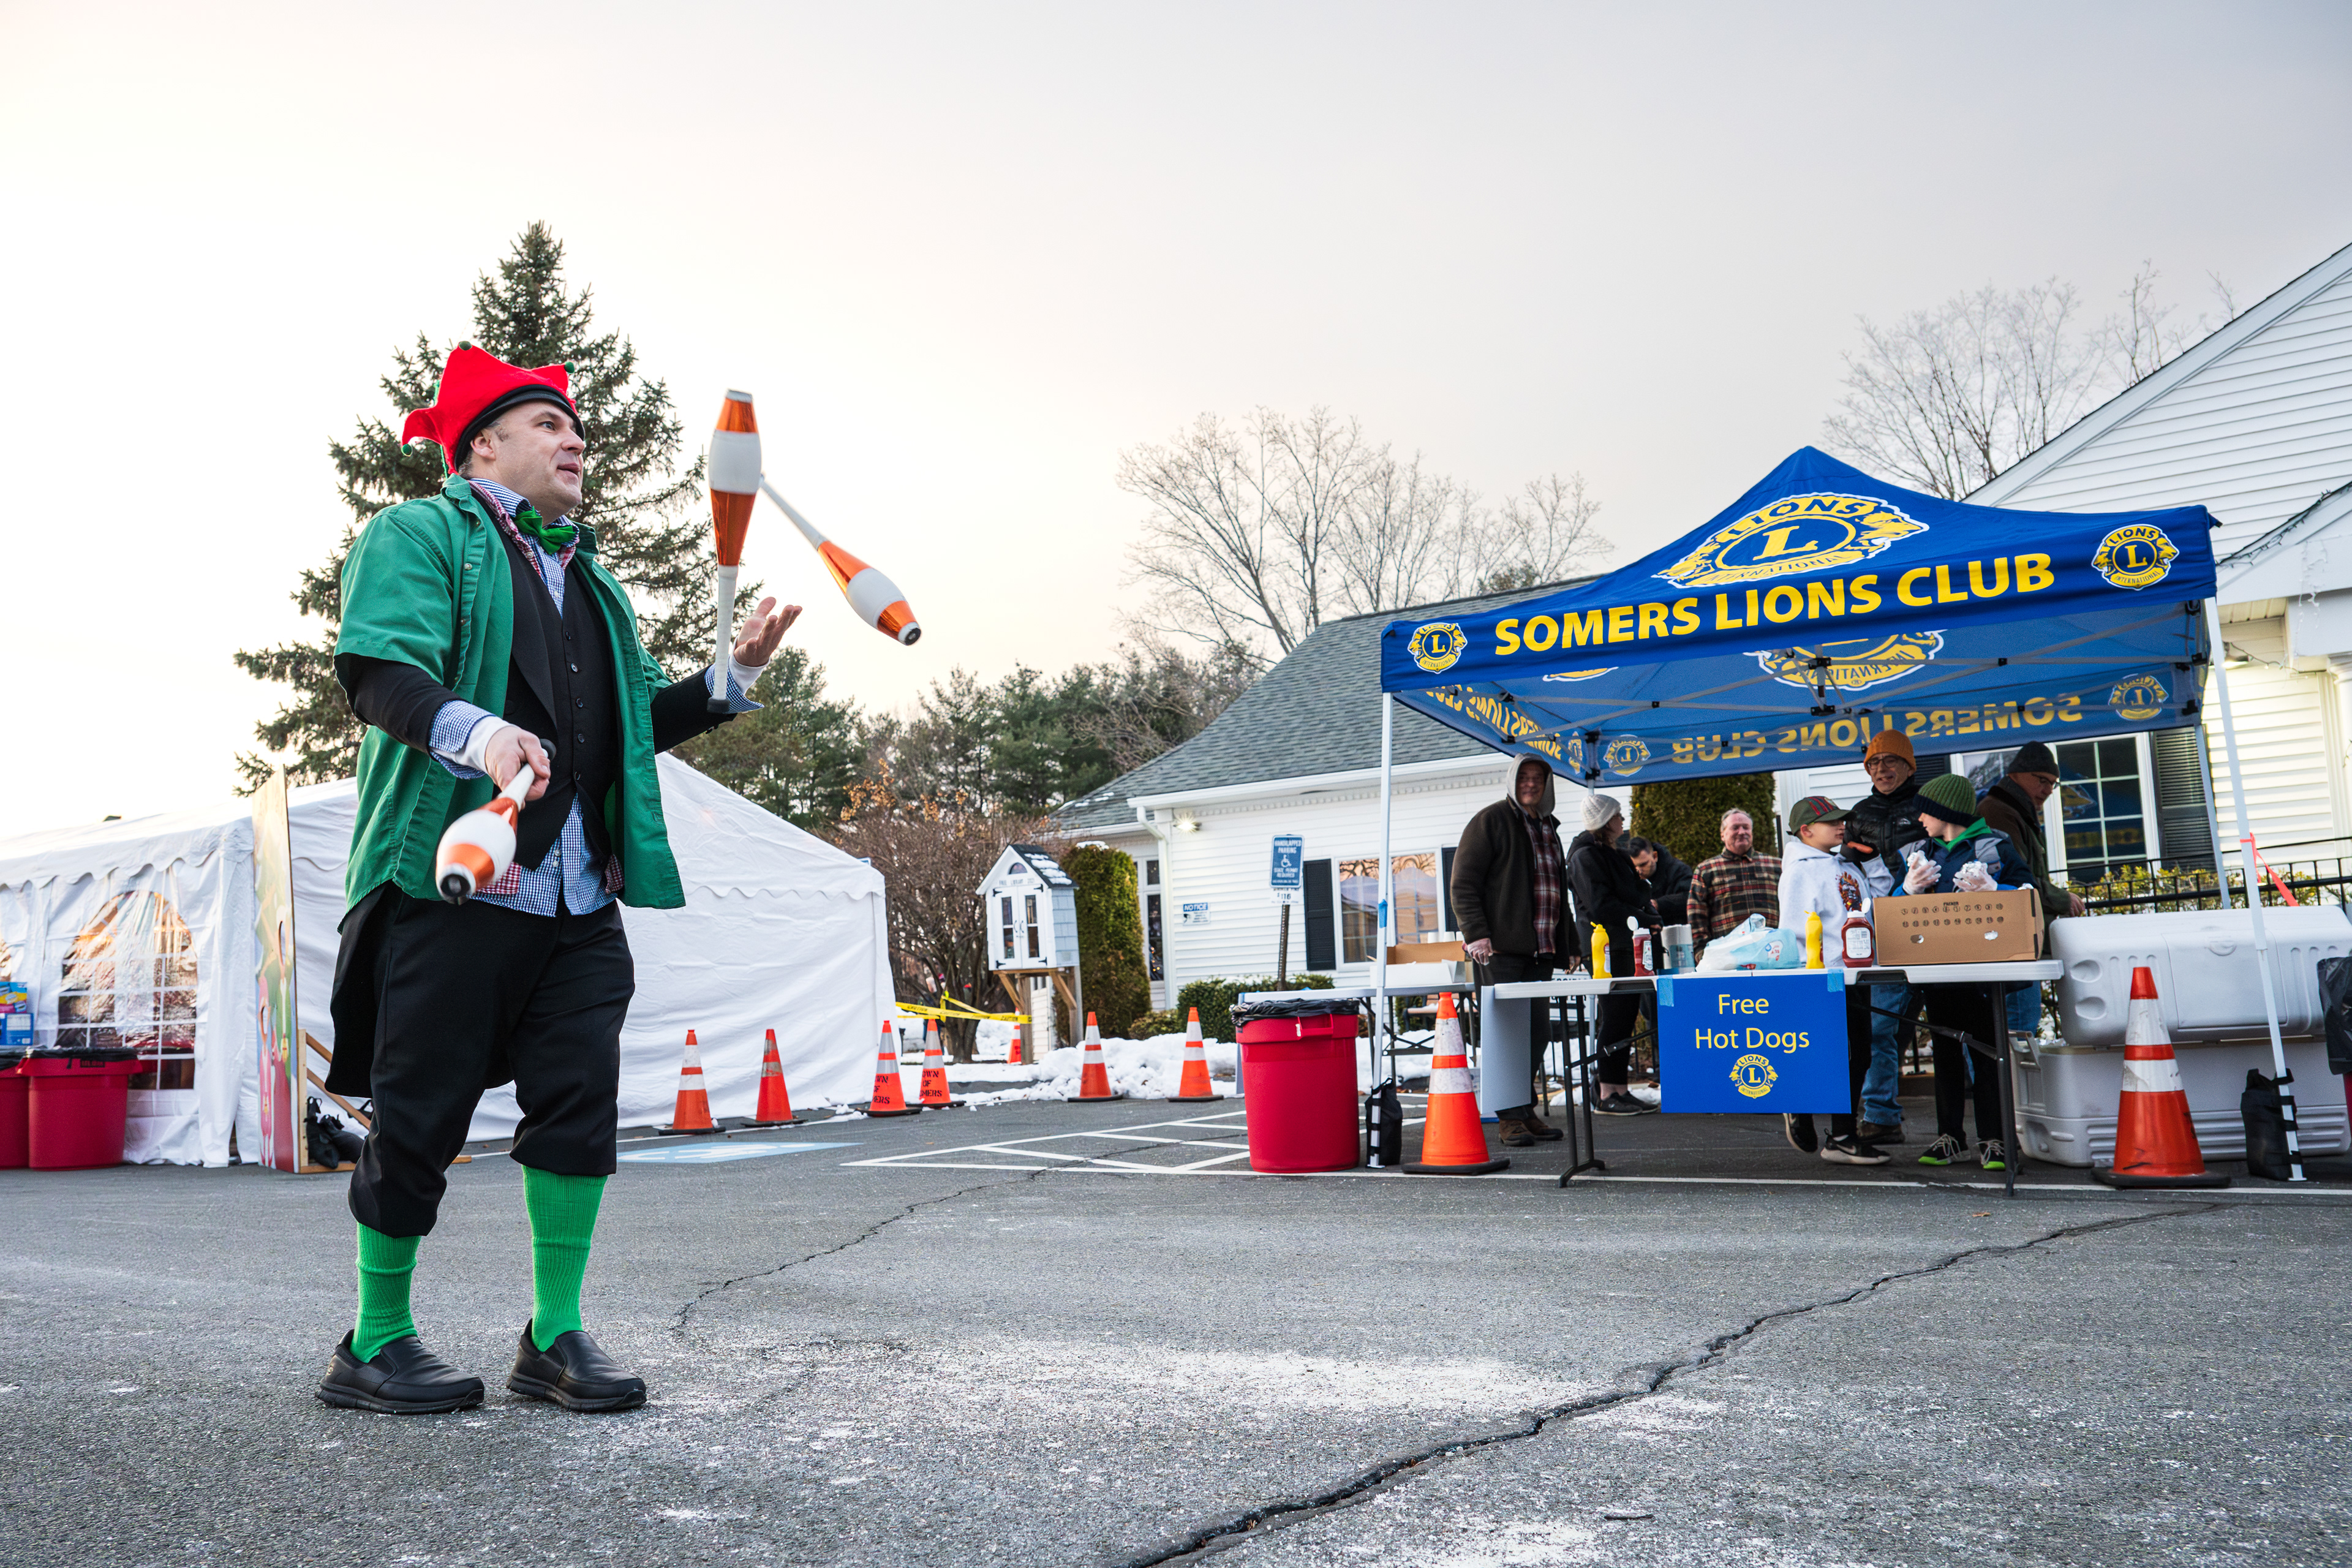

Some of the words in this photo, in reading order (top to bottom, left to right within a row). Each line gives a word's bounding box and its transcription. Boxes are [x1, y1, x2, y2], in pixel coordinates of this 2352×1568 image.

[1728, 499, 1867, 537] LIONS
[1753, 525, 1819, 561] L
[2109, 527, 2157, 545] LIONS
[2125, 545, 2148, 568] L
[1706, 554, 1847, 585] INTERNATIONAL
[2114, 570, 2161, 584] INTERNATIONAL
[1495, 598, 1701, 655] SOMERS
[1716, 575, 1882, 630] LIONS
[1897, 553, 2054, 606] CLUB
[1431, 635, 1446, 653] L
[1719, 994, 1769, 1014] Free
[1695, 1028, 1738, 1049] Hot
[1746, 1028, 1810, 1054] Dogs
[1739, 1055, 1767, 1065] LIONS
[1748, 1068, 1761, 1083] L
